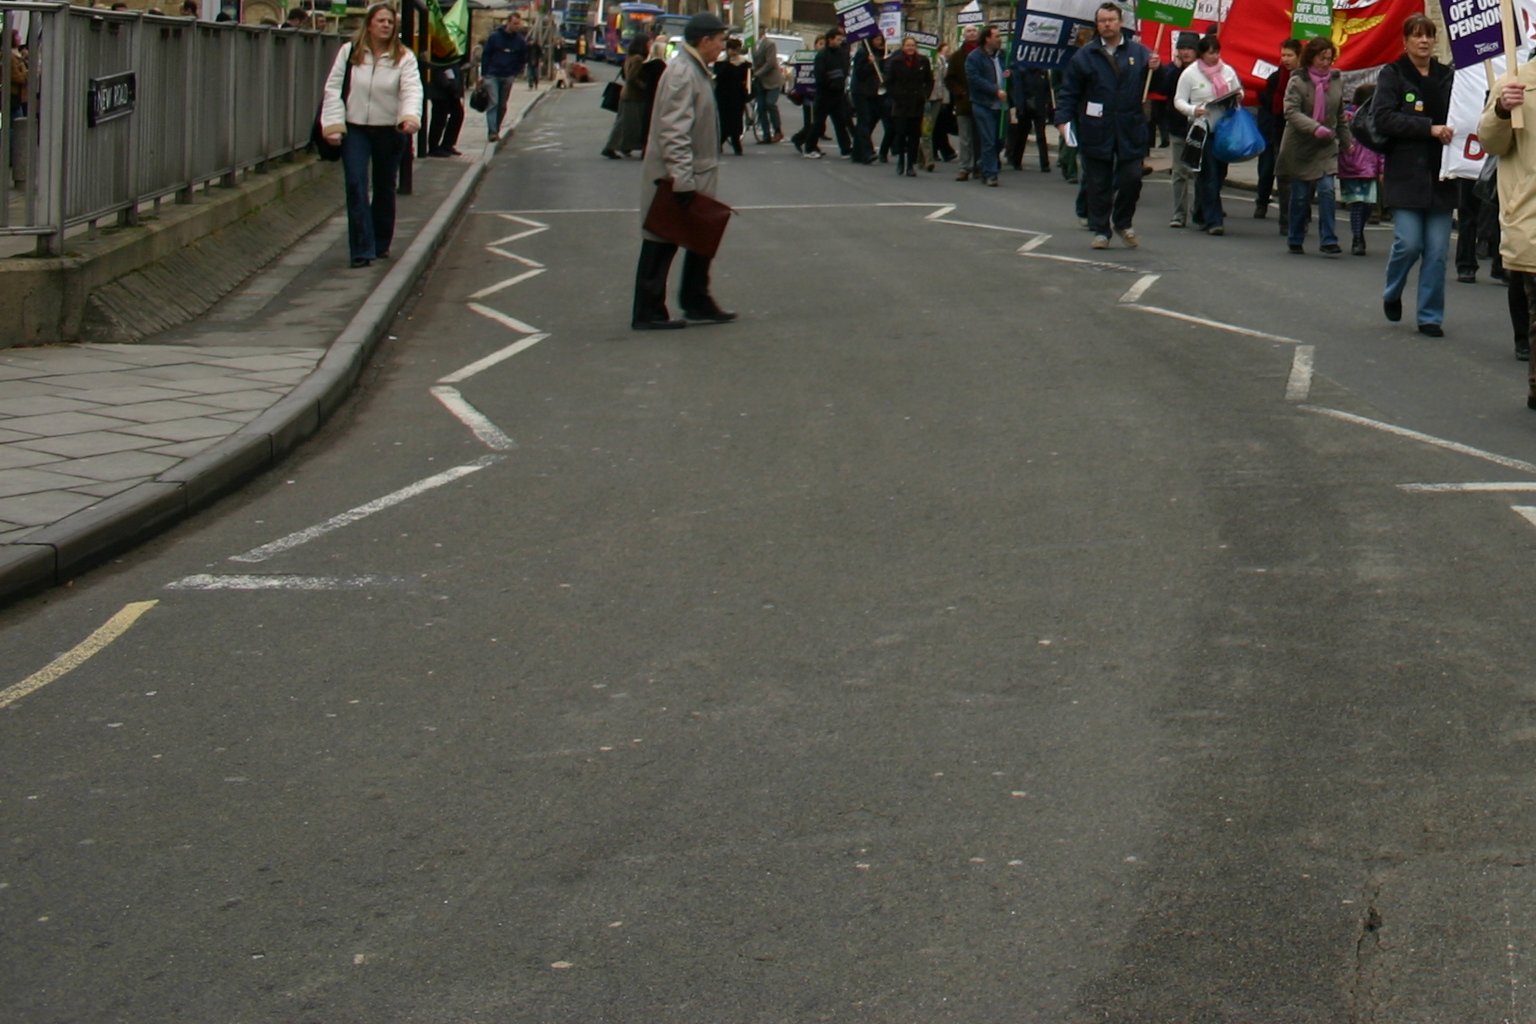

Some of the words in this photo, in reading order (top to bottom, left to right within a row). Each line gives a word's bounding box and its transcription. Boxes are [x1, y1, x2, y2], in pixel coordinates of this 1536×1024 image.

[1293, 12, 1331, 26] PENSIONS
[1296, 2, 1311, 13] OFF
[1312, 4, 1329, 15] OUR
[1449, 0, 1475, 22] OFF
[1448, 5, 1502, 41] PENSION
[1016, 44, 1066, 65] UNITY
